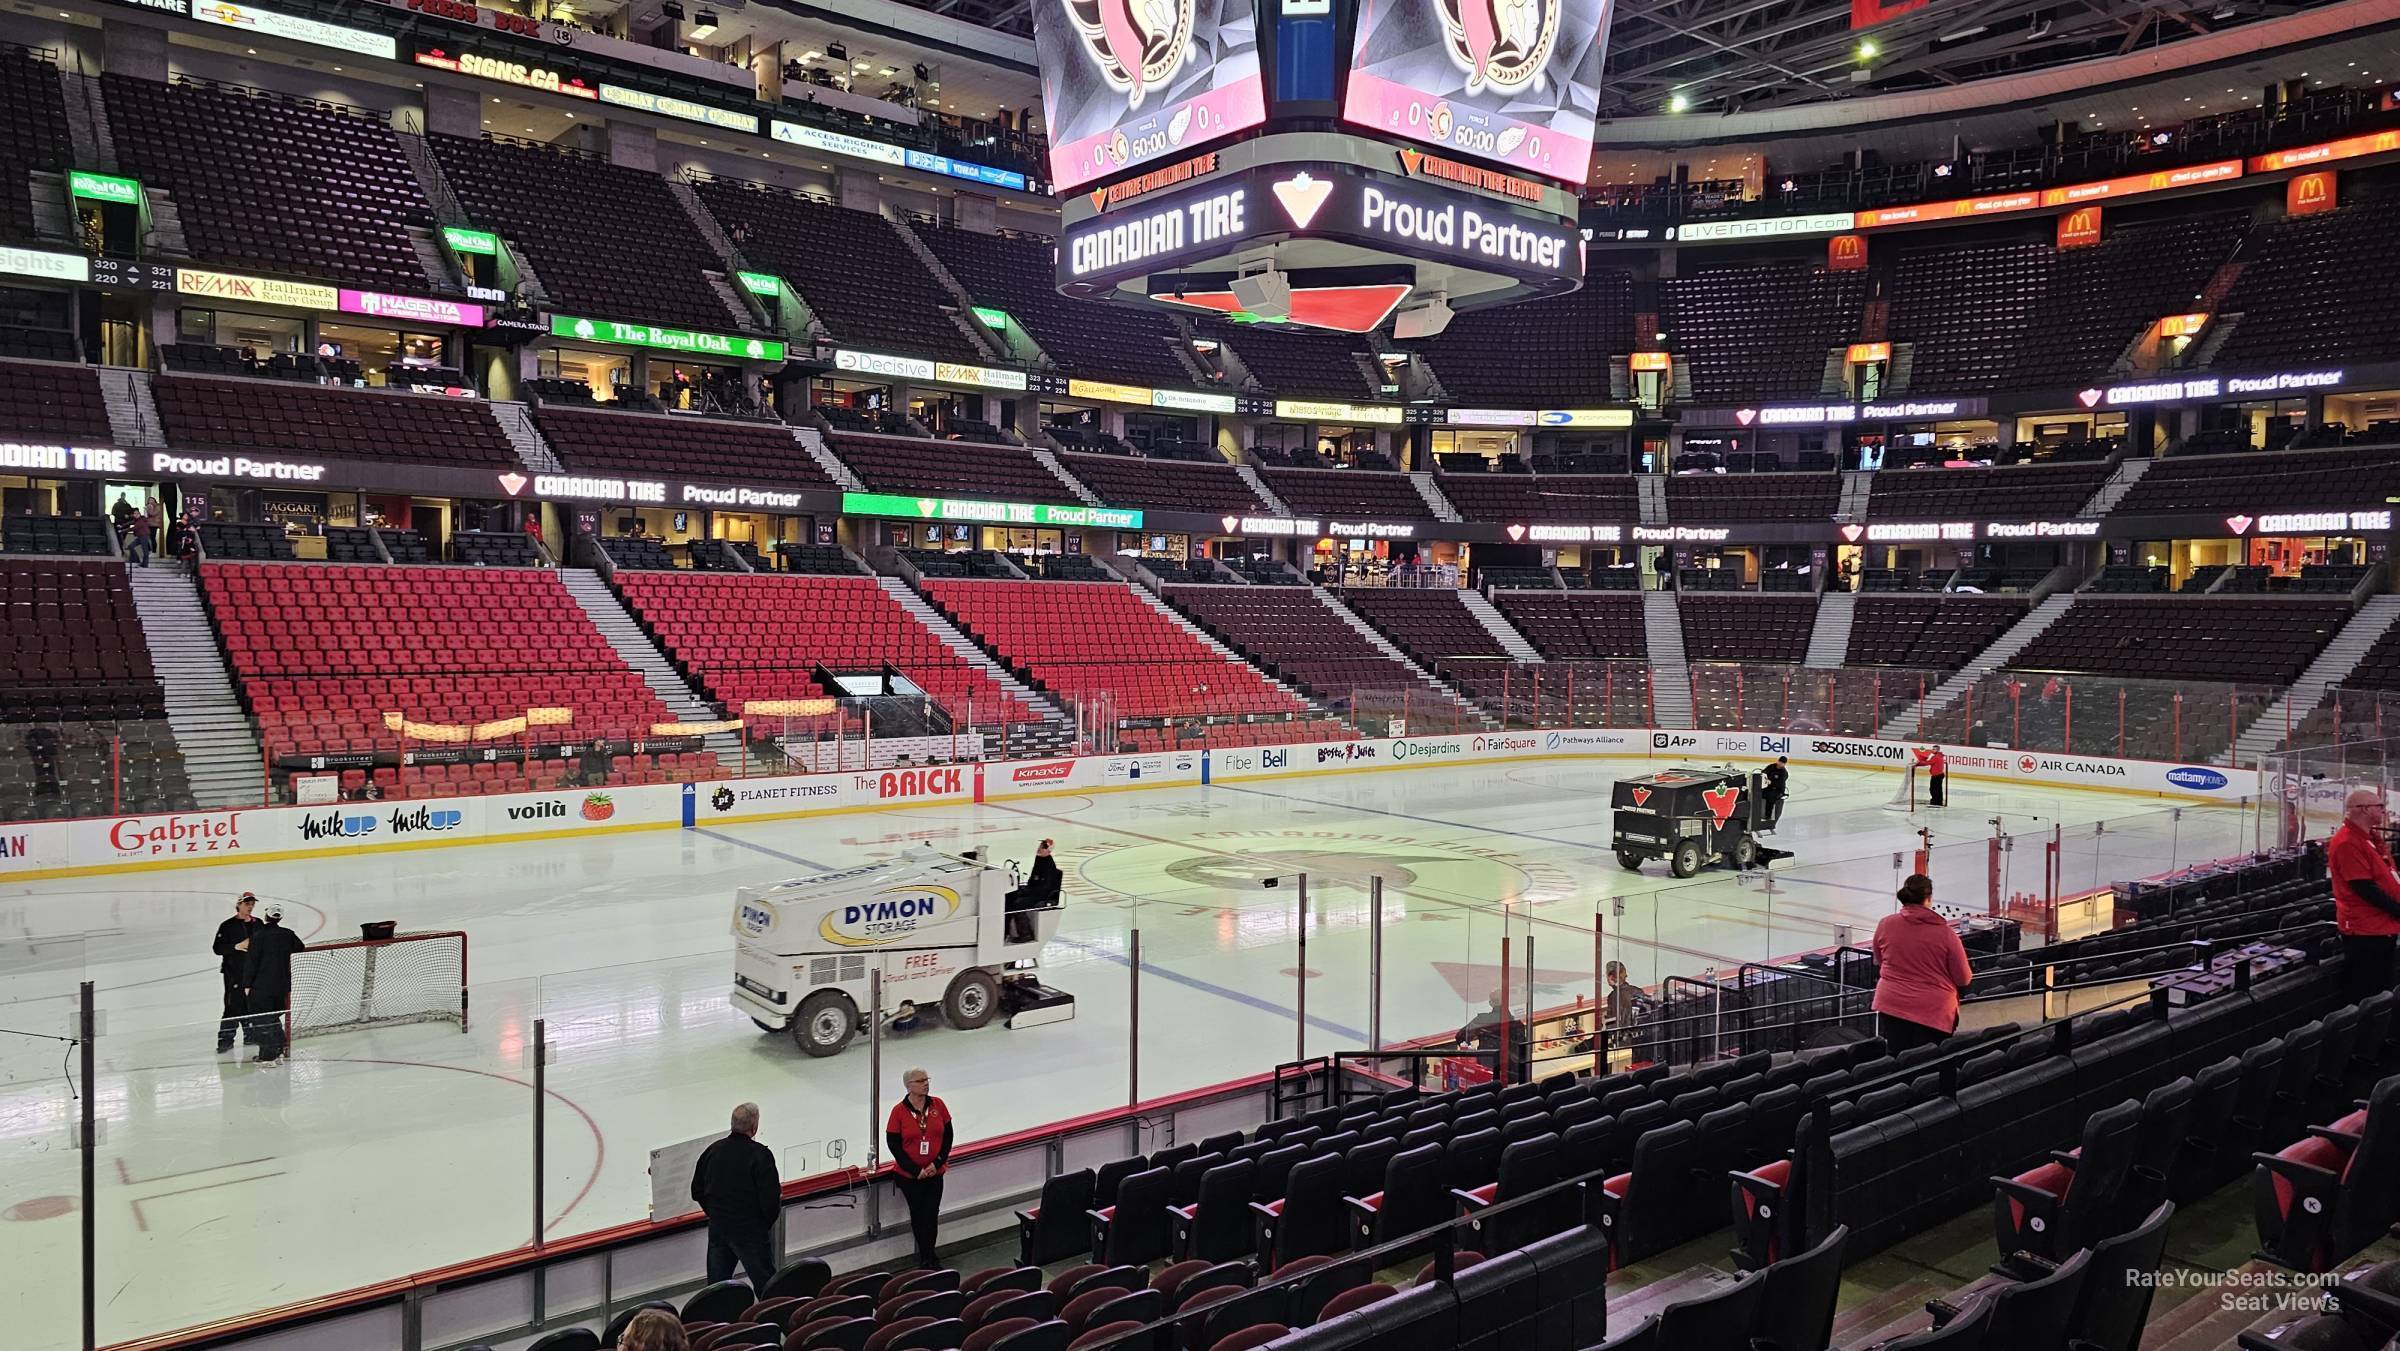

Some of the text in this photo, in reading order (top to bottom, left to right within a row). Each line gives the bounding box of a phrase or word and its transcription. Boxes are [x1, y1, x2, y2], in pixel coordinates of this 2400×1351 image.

[407, 0, 541, 38] PRESS BOX
[554, 28, 570, 40] 18
[459, 53, 560, 92] SIGNS.CA
[1198, 106, 1209, 129] 0
[1408, 102, 1421, 125] 0
[803, 129, 885, 152] ACCESS RIGGING
[821, 140, 868, 155] SERVICES
[1132, 131, 1166, 158] 60:00
[1455, 125, 1494, 152] 60:00
[1529, 137, 1540, 159] 0
[1094, 145, 1104, 166] 0
[1108, 152, 1216, 204] CENTRE CANADIAN TIRE
[1424, 155, 1482, 187] CANADIAN
[1482, 168, 1507, 193] TIRE
[1072, 190, 1245, 275] CANADIAN TIRE
[1363, 187, 1566, 269] Proud Partner
[1683, 218, 1849, 239] LIVENATION.com
[95, 259, 172, 276] 320 321
[95, 273, 172, 290] 220 221
[181, 273, 333, 298] RE/MAX Hallmark
[263, 291, 334, 310] Realty Group
[382, 295, 461, 316] MAGENTA
[497, 319, 550, 332] CAMERA STAND
[611, 322, 732, 352] The Royal Oak
[859, 354, 928, 377] Decisive
[938, 364, 1024, 383] RE/MAX Hallmark
[1029, 374, 1067, 386] 323 324
[1029, 384, 1067, 395] 223 224
[2107, 370, 2343, 405] CANADIAN TIRE Proud Partner
[1760, 402, 1958, 424] CANADIAN TIRE Proud Partner
[69, 447, 325, 481] TIRE Proud Partner
[185, 496, 205, 505] 115
[534, 475, 802, 507] CANADIAN TIRE Proud Partner
[263, 502, 318, 514] TAGGART
[943, 501, 1133, 525] CANADIAN TIRE Proud Partner
[580, 514, 595, 522] 116
[1241, 518, 1414, 537] CANADIAN TIRE Proud Partner
[2259, 511, 2391, 532] CANADIAN TIRE
[818, 525, 833, 533] 116
[1529, 526, 1729, 540] CANADIAN TIRE Proud Partner
[1867, 521, 2100, 540] CANADIAN TIRE Proud Partner
[1409, 742, 1460, 757] Desjardins
[1487, 738, 1536, 750] FairSquare
[1562, 736, 1624, 747] Pathways Alliance
[1716, 737, 1747, 751] Fibe
[1761, 736, 1790, 753] Bell
[1226, 755, 1252, 770] Fibe
[1262, 749, 1287, 768] Bell
[1318, 746, 1376, 762] Booster Juice
[1987, 759, 2008, 770] TIRE
[2041, 760, 2126, 776] AIR CANADA
[740, 785, 837, 801] PLANET FITNESS
[854, 769, 961, 799] The BRICK
[508, 800, 566, 820] voilà
[109, 813, 242, 851] Gabriel
[152, 839, 241, 854] PIZZA
[782, 862, 890, 889] DYMON
[741, 905, 771, 928] DYMON
[845, 897, 935, 925] DYMON
[864, 919, 918, 936] STORAGE
[905, 953, 939, 969] FREE
[911, 970, 926, 979] and
[930, 966, 956, 977] Driver
